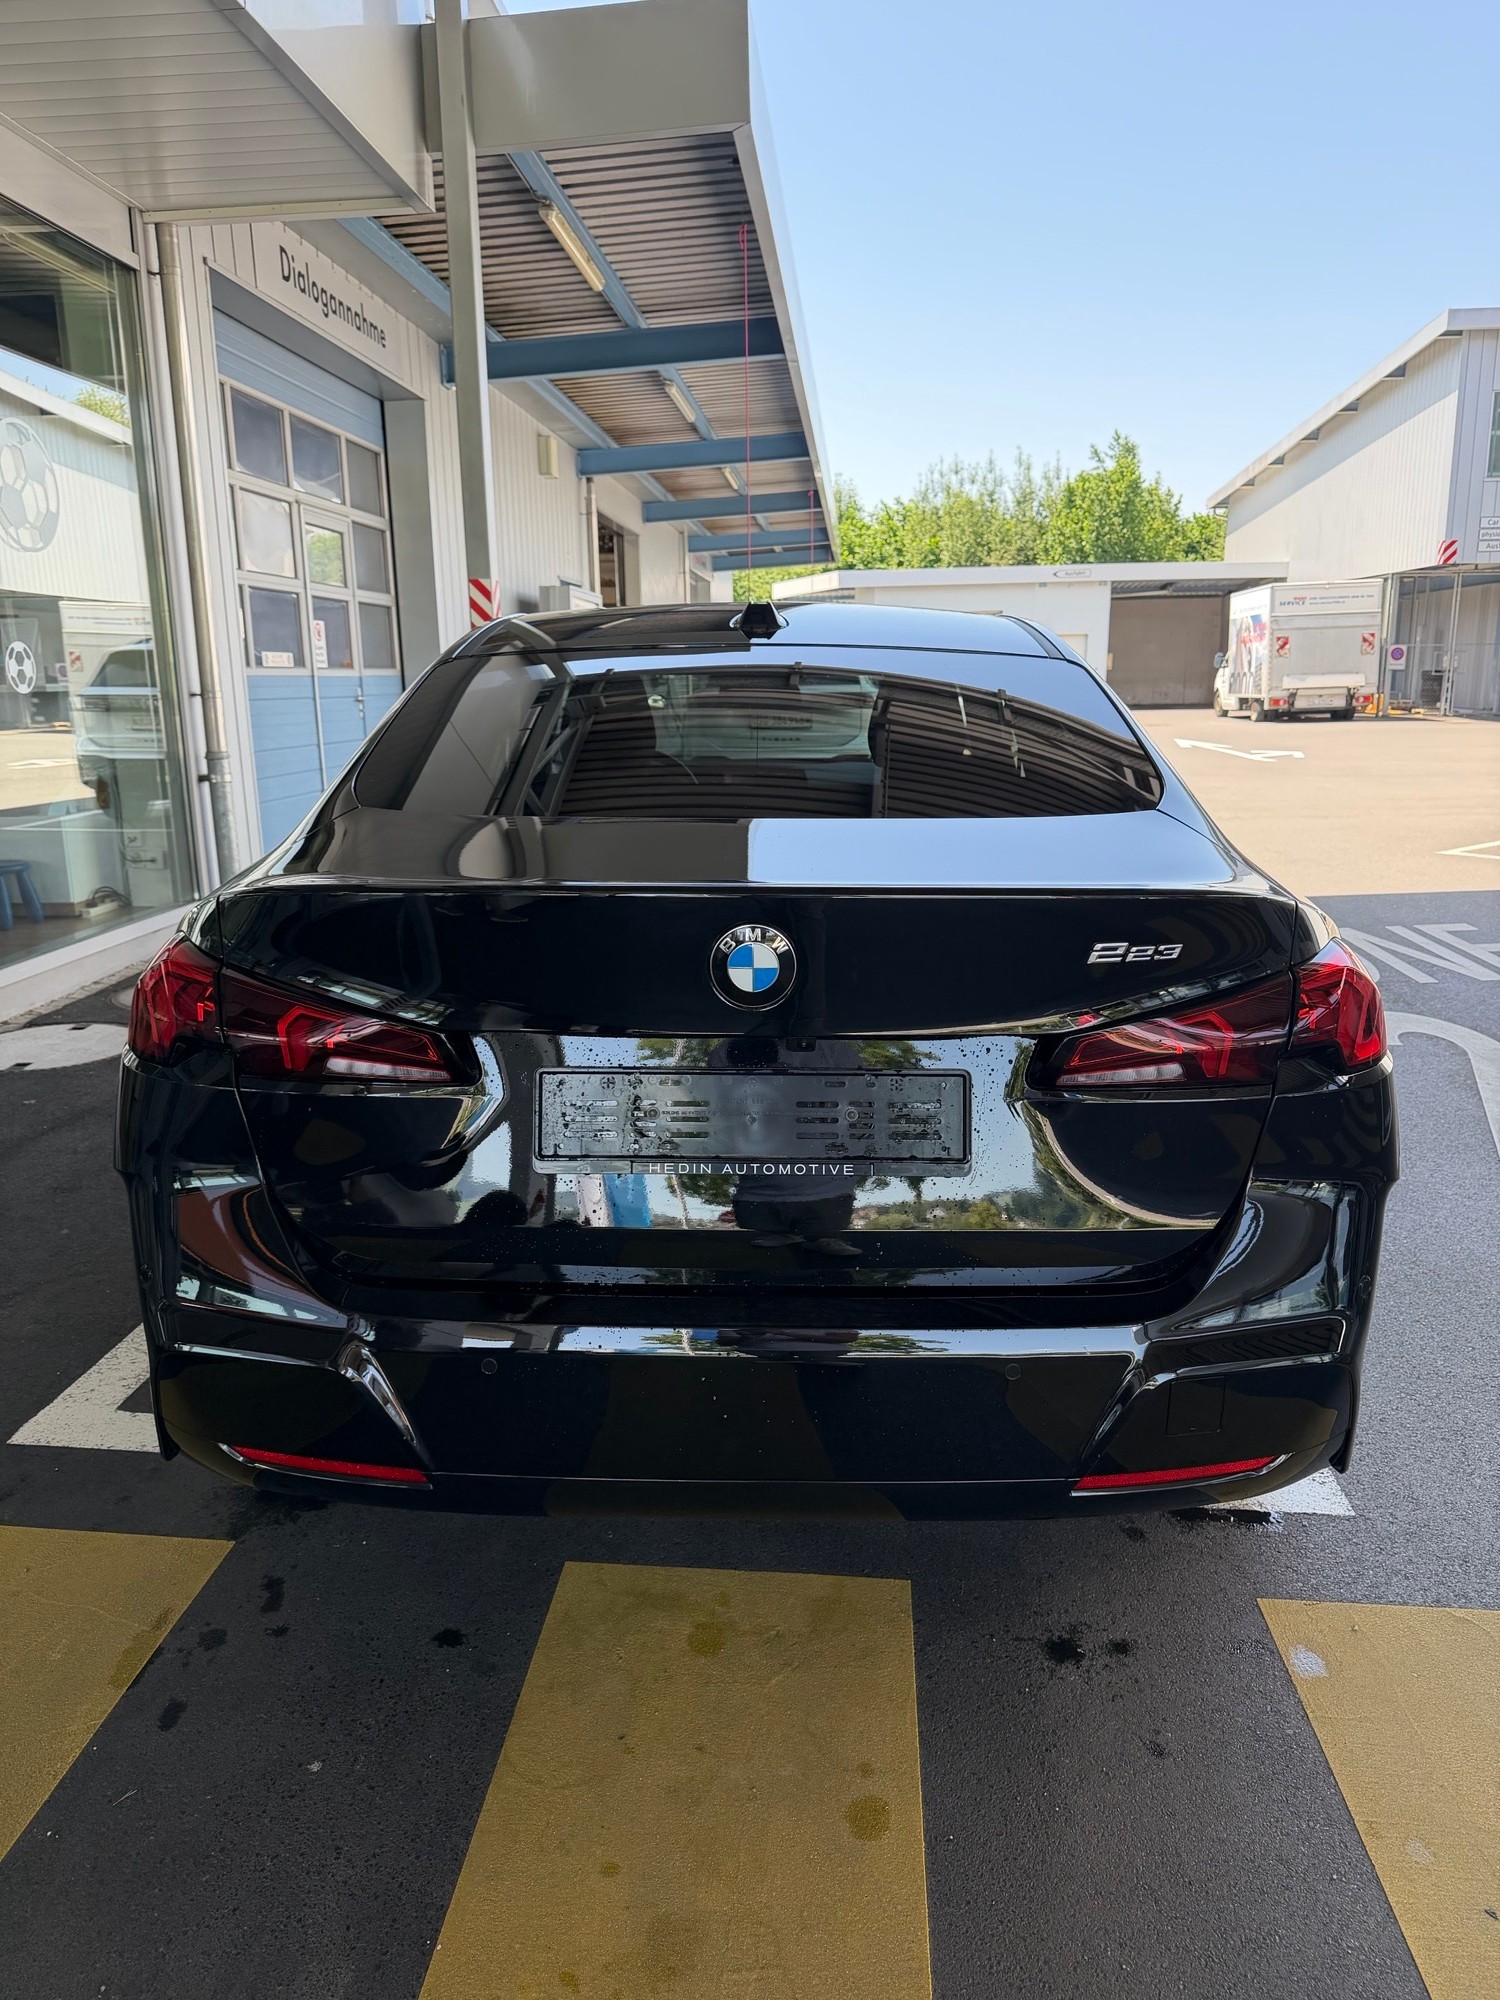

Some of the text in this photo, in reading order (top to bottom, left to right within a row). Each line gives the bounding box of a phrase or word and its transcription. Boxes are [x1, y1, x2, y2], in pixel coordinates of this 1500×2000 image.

[279, 244, 387, 349] Dialogannahme
[719, 927, 790, 955] BMW
[649, 1162, 855, 1176] HEDIN AUTOMOTIVE
